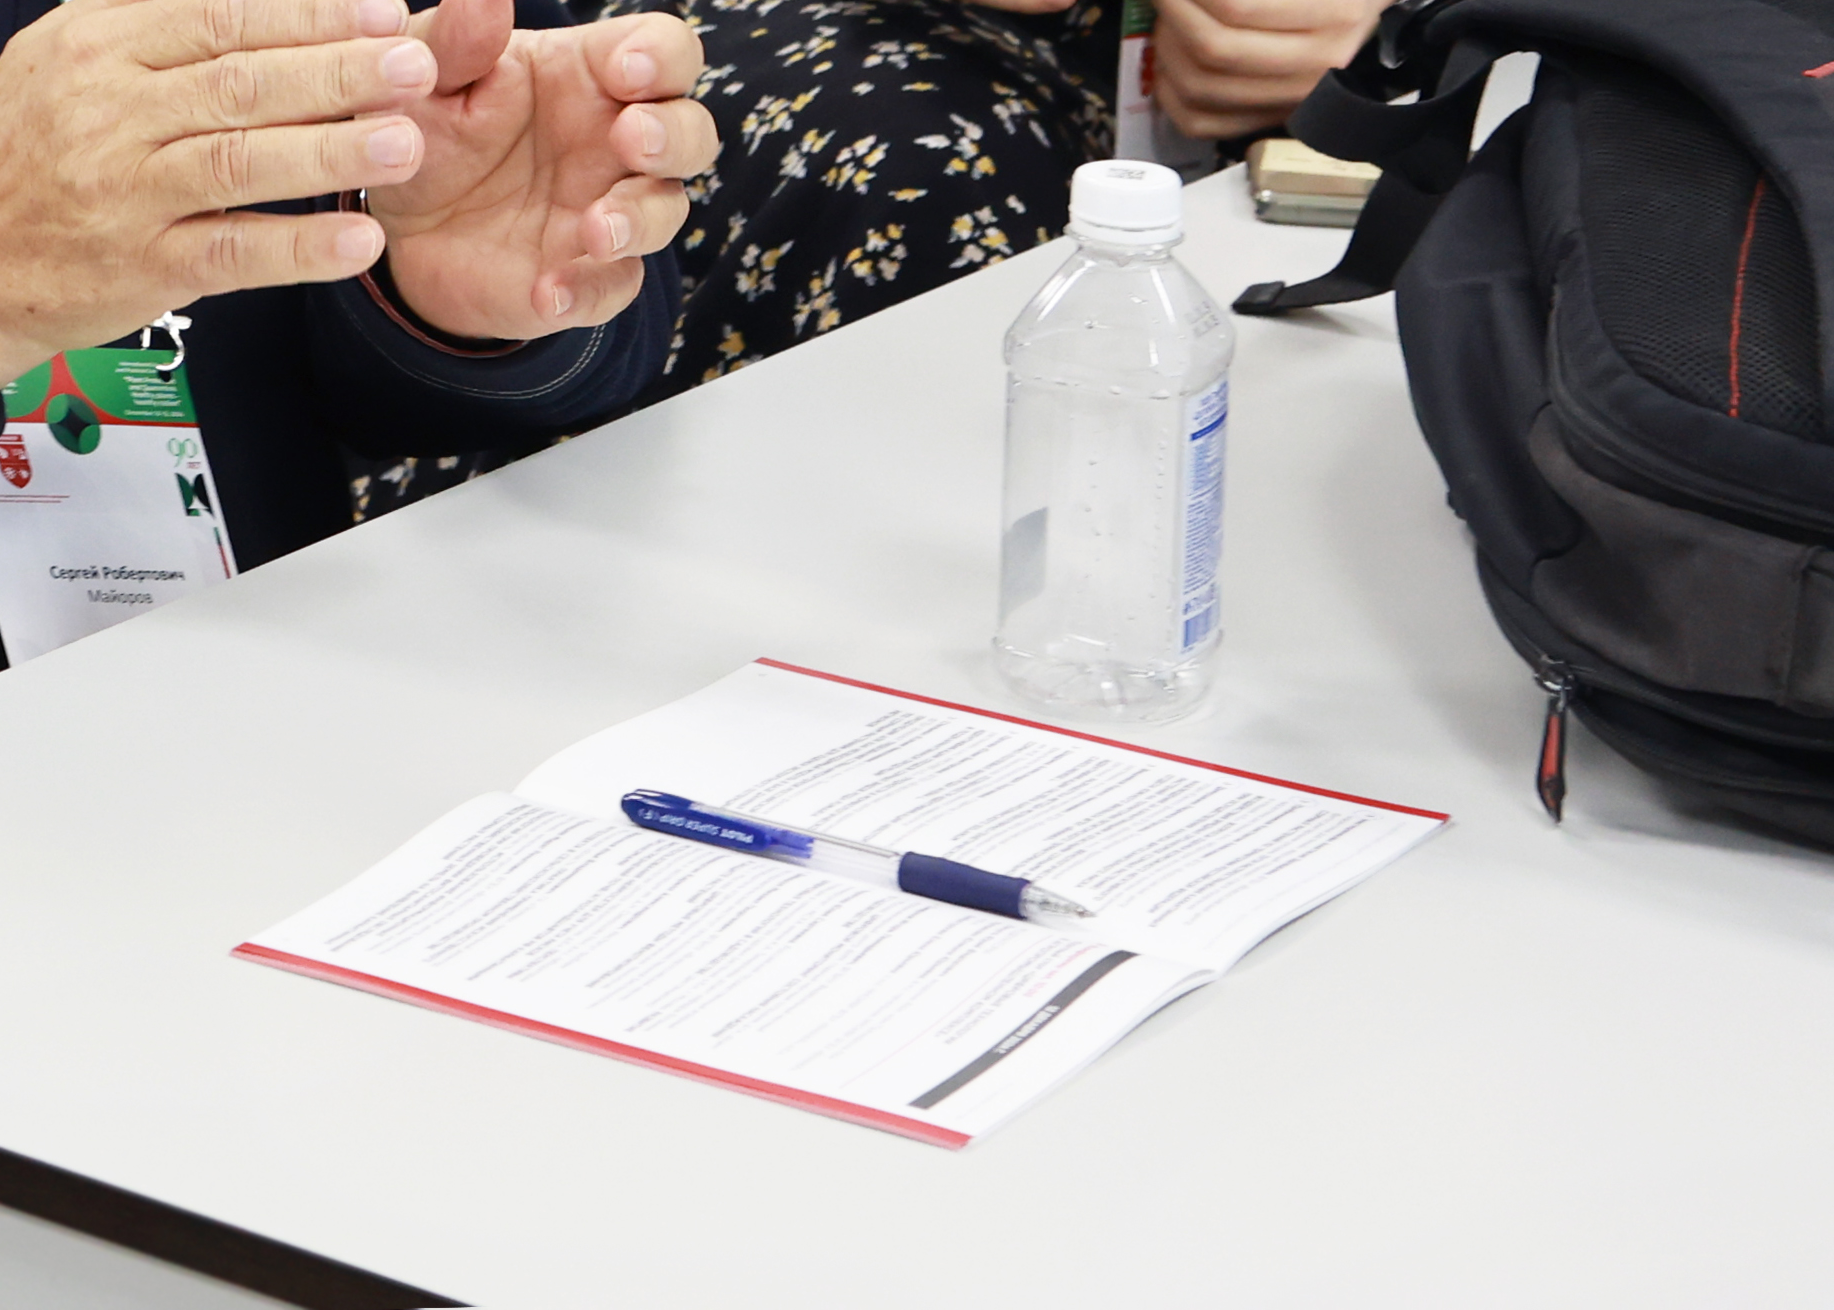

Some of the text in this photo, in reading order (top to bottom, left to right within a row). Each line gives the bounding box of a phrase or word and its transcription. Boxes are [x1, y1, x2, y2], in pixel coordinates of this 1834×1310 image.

[49, 565, 187, 584] Сергей Робертович
[87, 589, 154, 607] Майоров
[719, 828, 755, 844] PILOT
